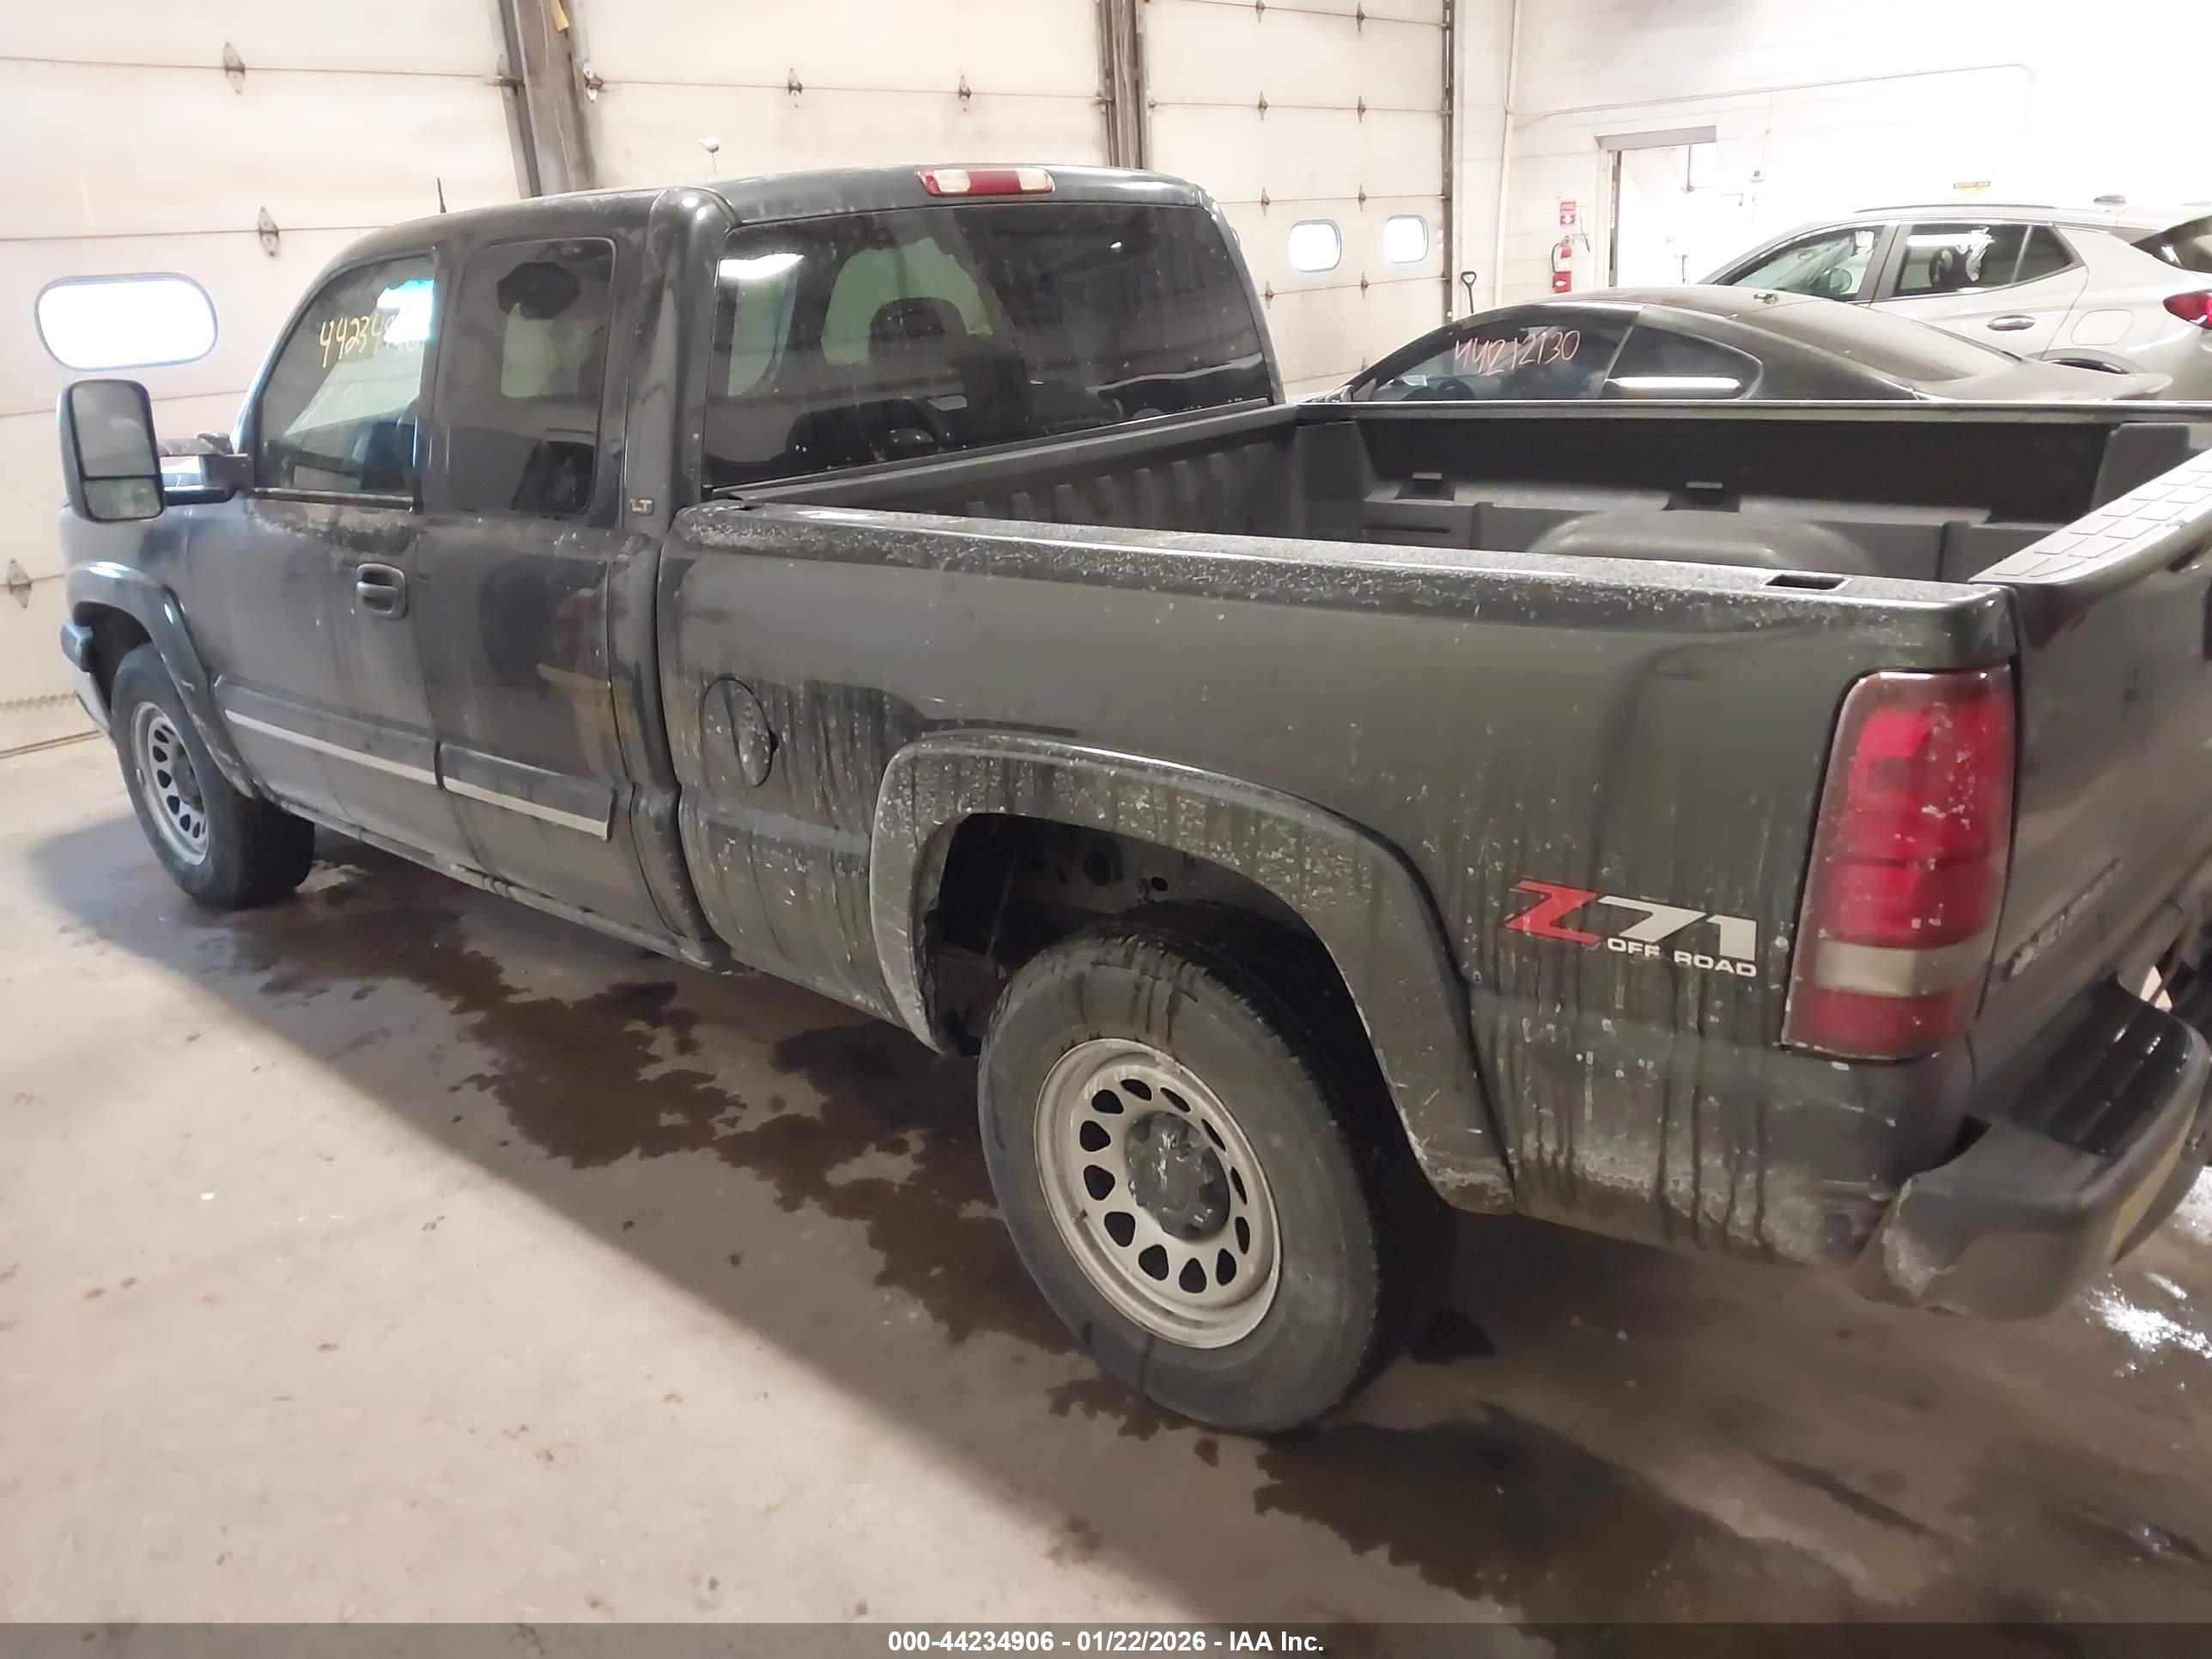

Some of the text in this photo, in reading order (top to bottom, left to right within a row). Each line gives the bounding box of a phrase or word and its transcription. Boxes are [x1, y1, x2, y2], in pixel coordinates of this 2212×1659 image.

[319, 313, 424, 368] 44234
[629, 498, 653, 513] LT
[1504, 879, 1758, 962] Z71
[1607, 937, 1758, 978] OFF ROAD
